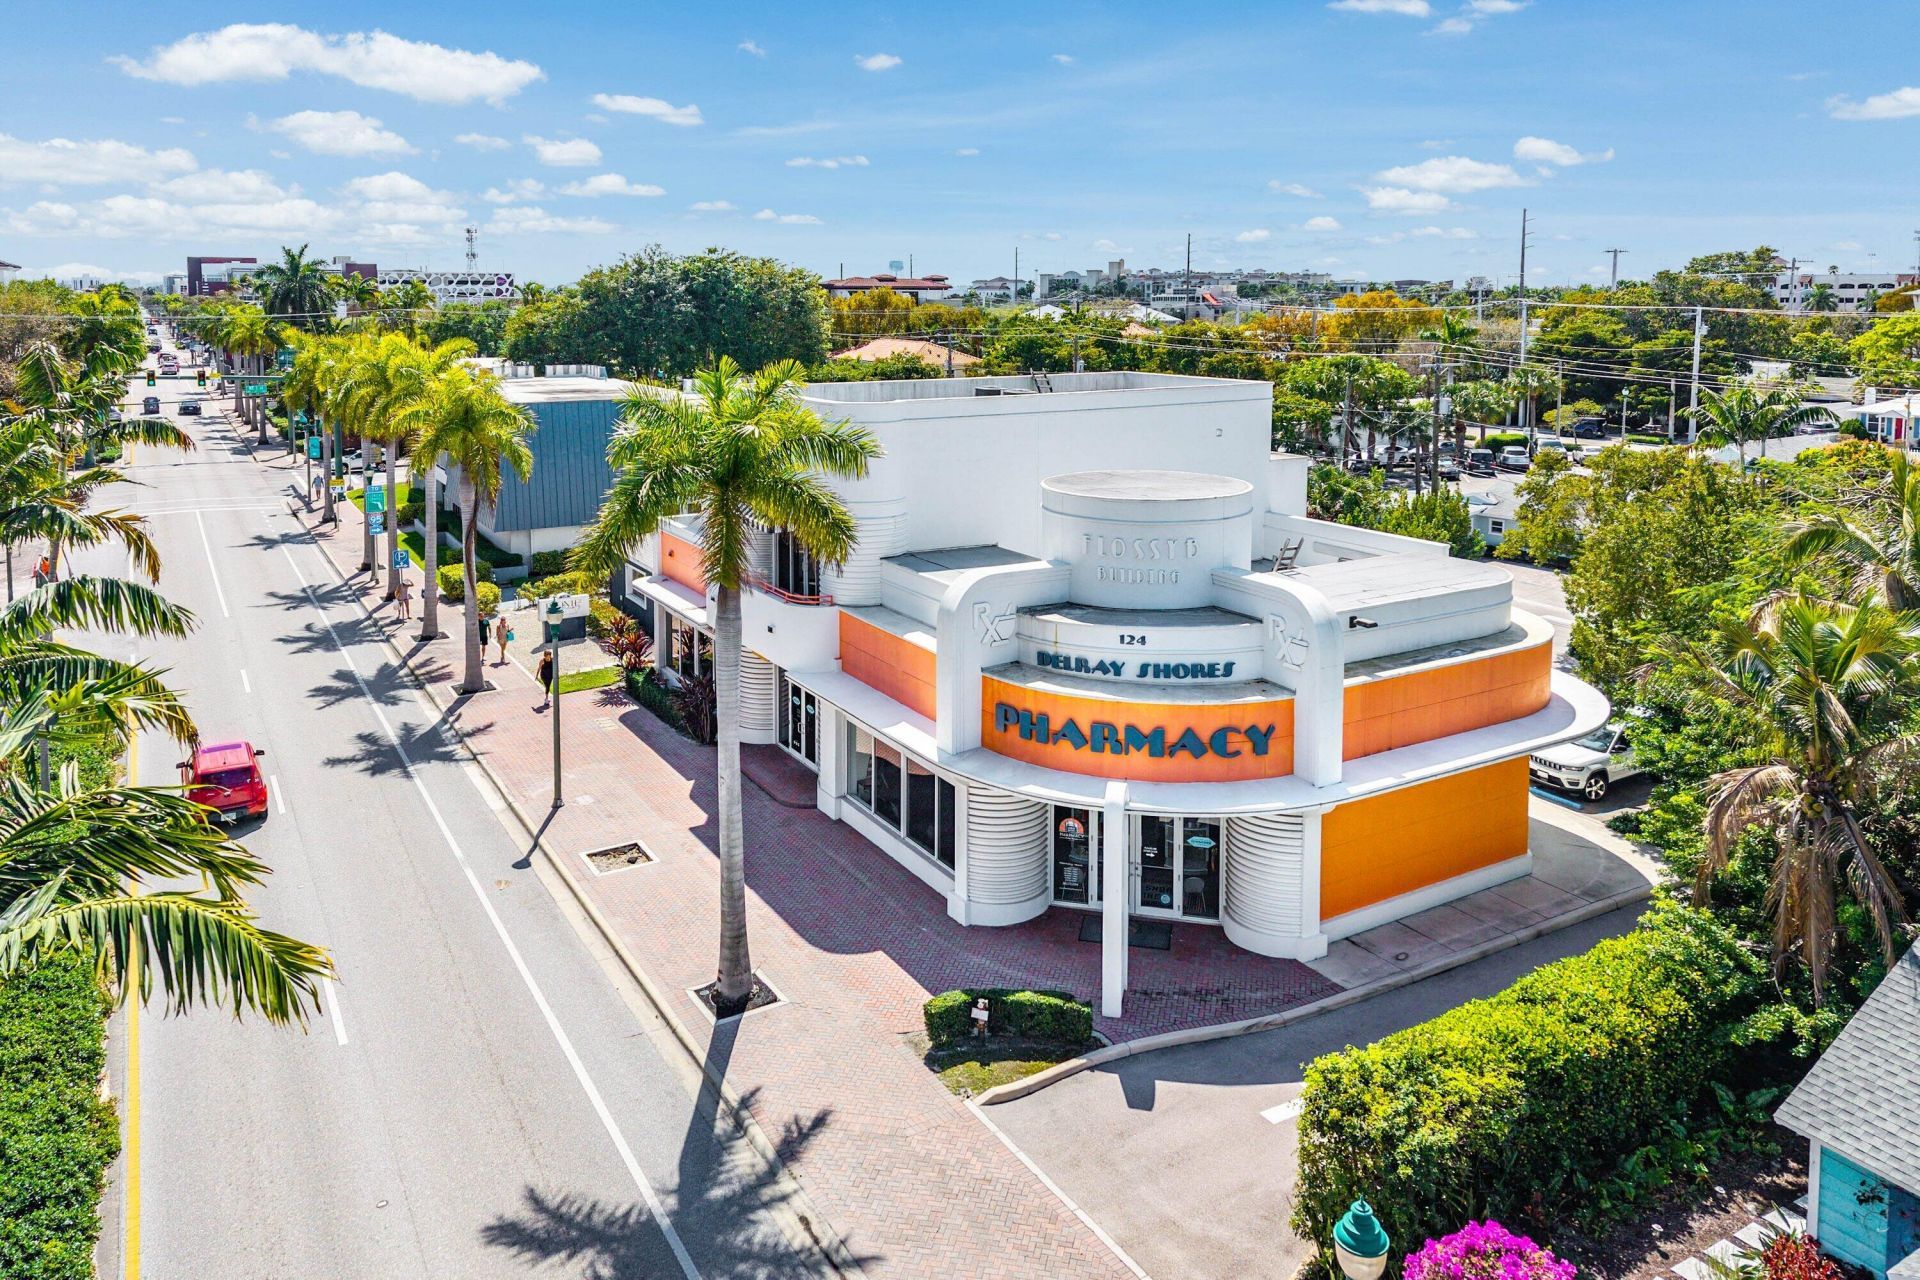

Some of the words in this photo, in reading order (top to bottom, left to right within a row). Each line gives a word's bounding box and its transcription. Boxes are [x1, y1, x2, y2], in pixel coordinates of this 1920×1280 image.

[370, 516, 382, 525] 95
[1097, 566, 1180, 584] BUILDING
[1119, 634, 1147, 646] 124
[1036, 650, 1125, 677] DELRAY
[1136, 661, 1236, 679] SHORES
[995, 702, 1276, 760] PHARMACY
